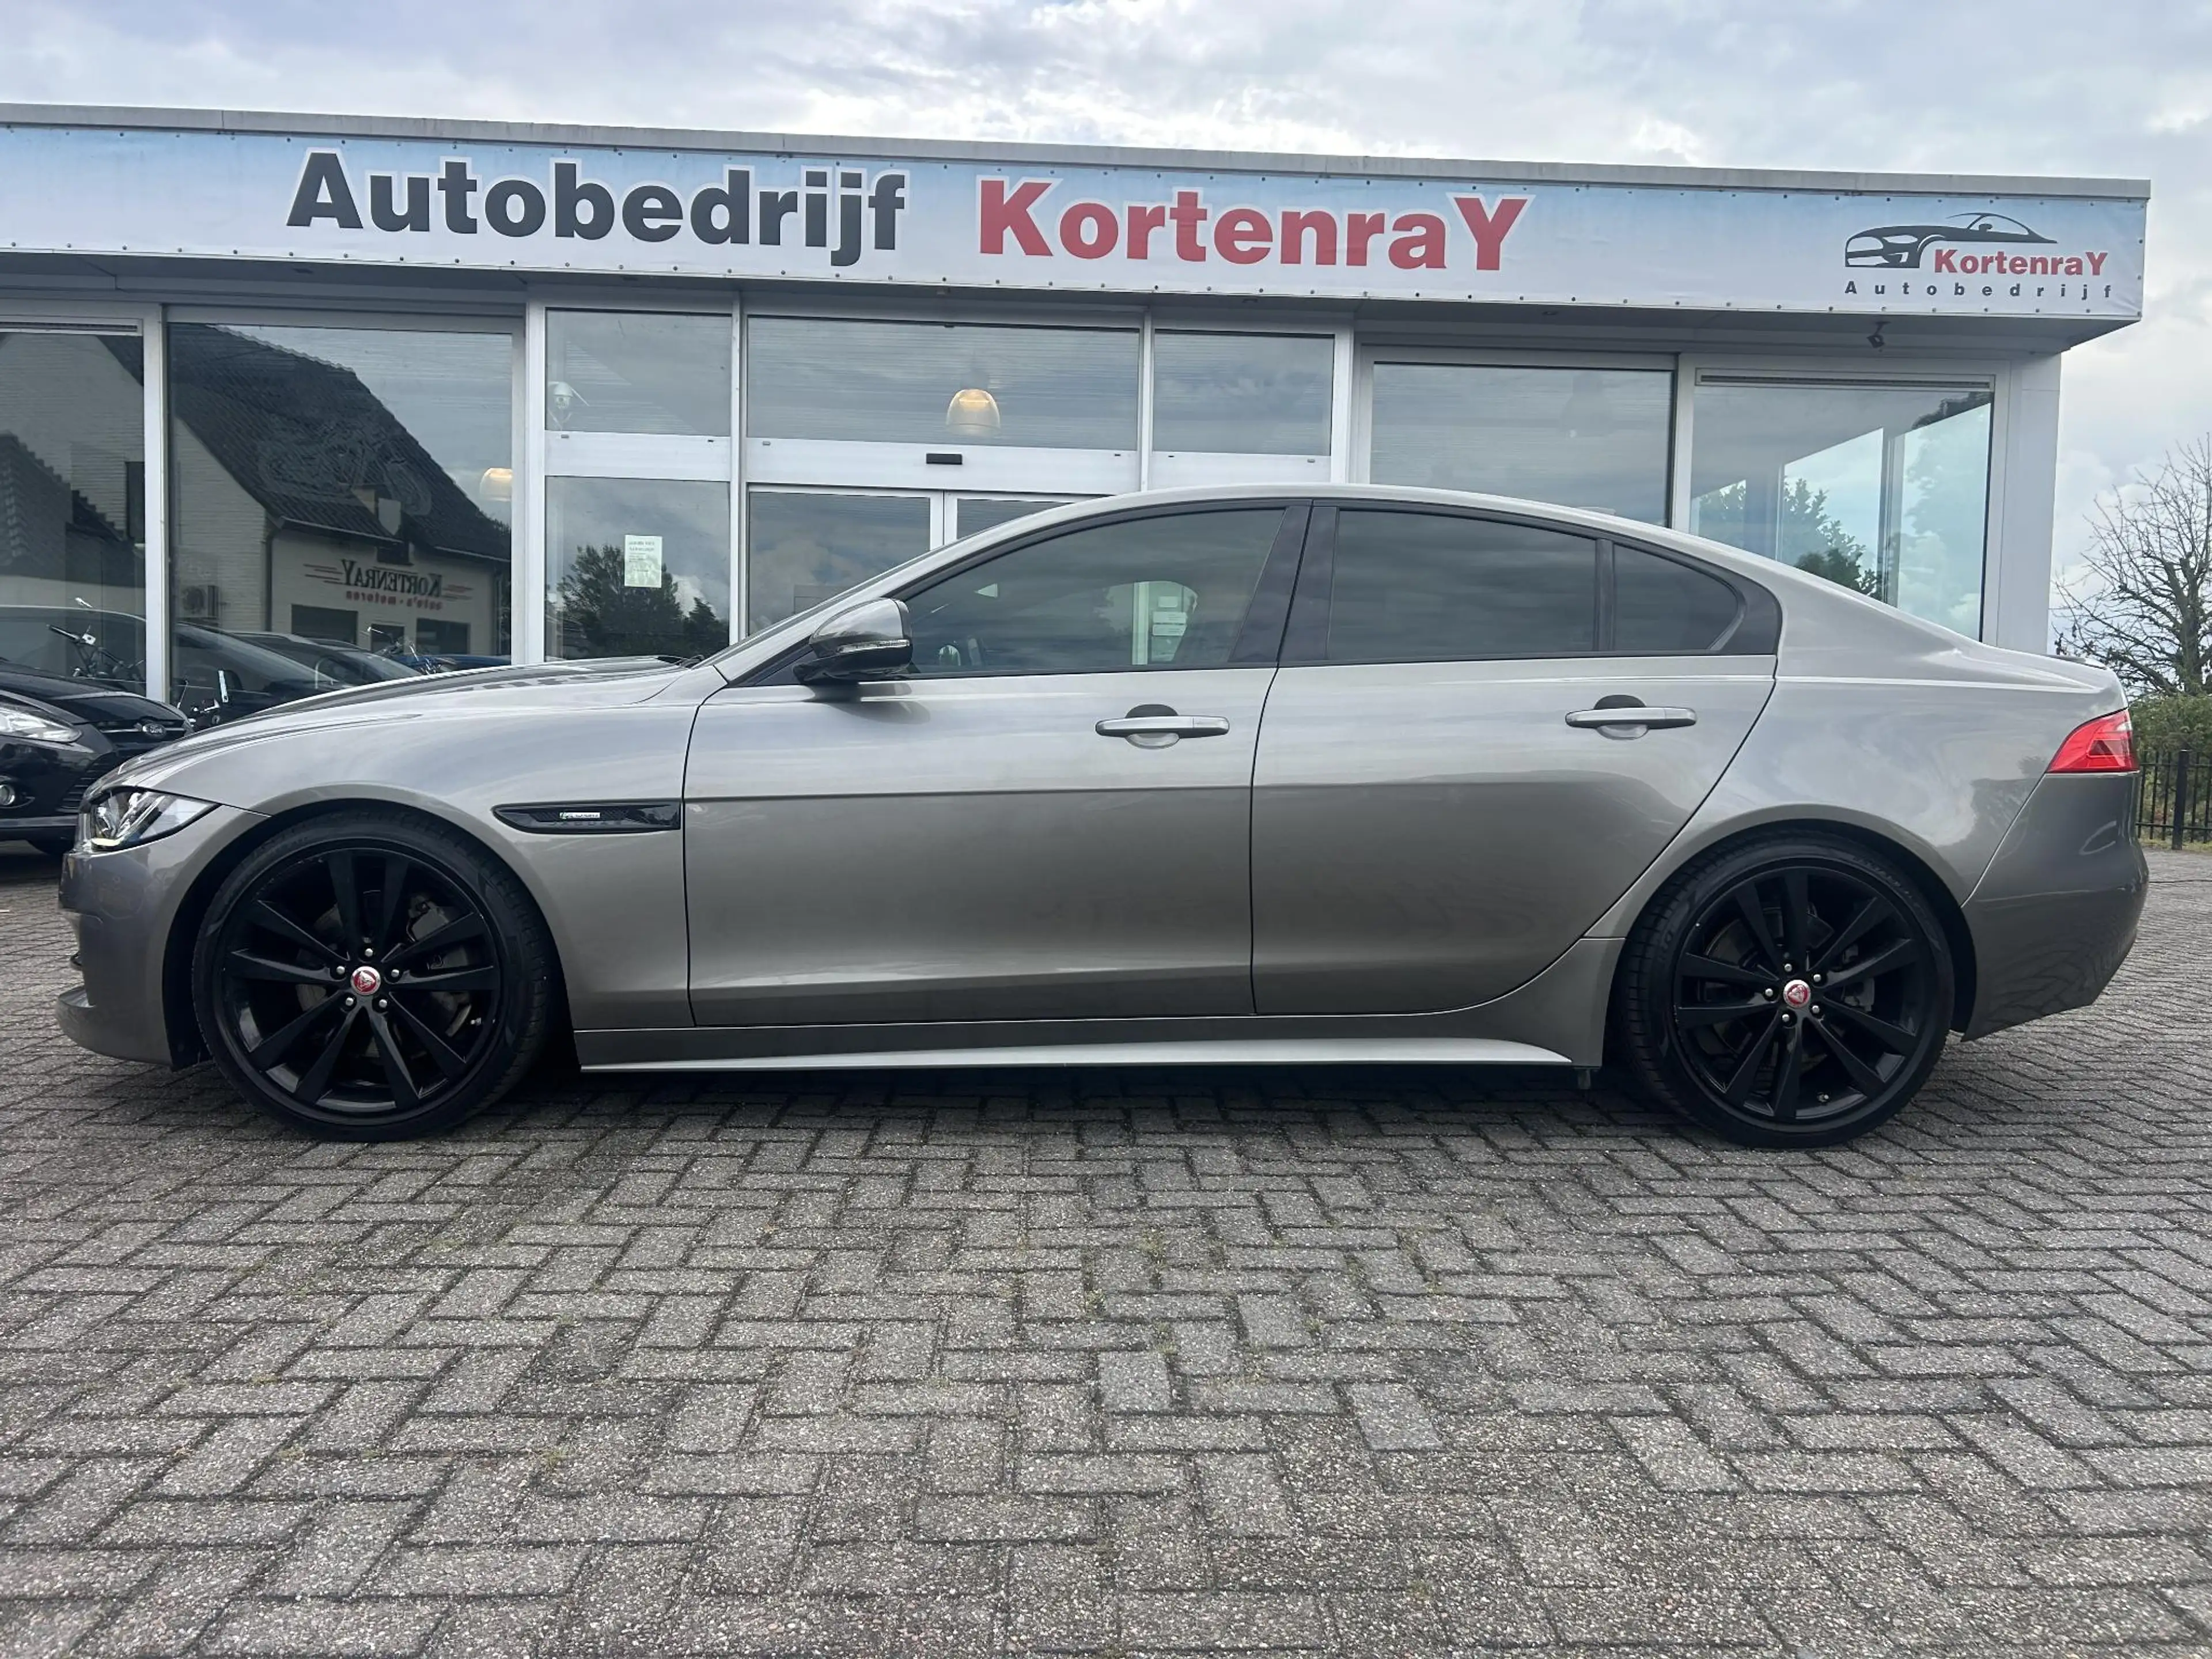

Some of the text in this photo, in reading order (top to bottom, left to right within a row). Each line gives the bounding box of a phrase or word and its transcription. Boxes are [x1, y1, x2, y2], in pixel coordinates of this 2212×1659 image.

[286, 152, 1526, 271] Autobedrijf KortenraY
[1934, 248, 2109, 276] KortenraY
[1844, 281, 2112, 300] Autobedrijf
